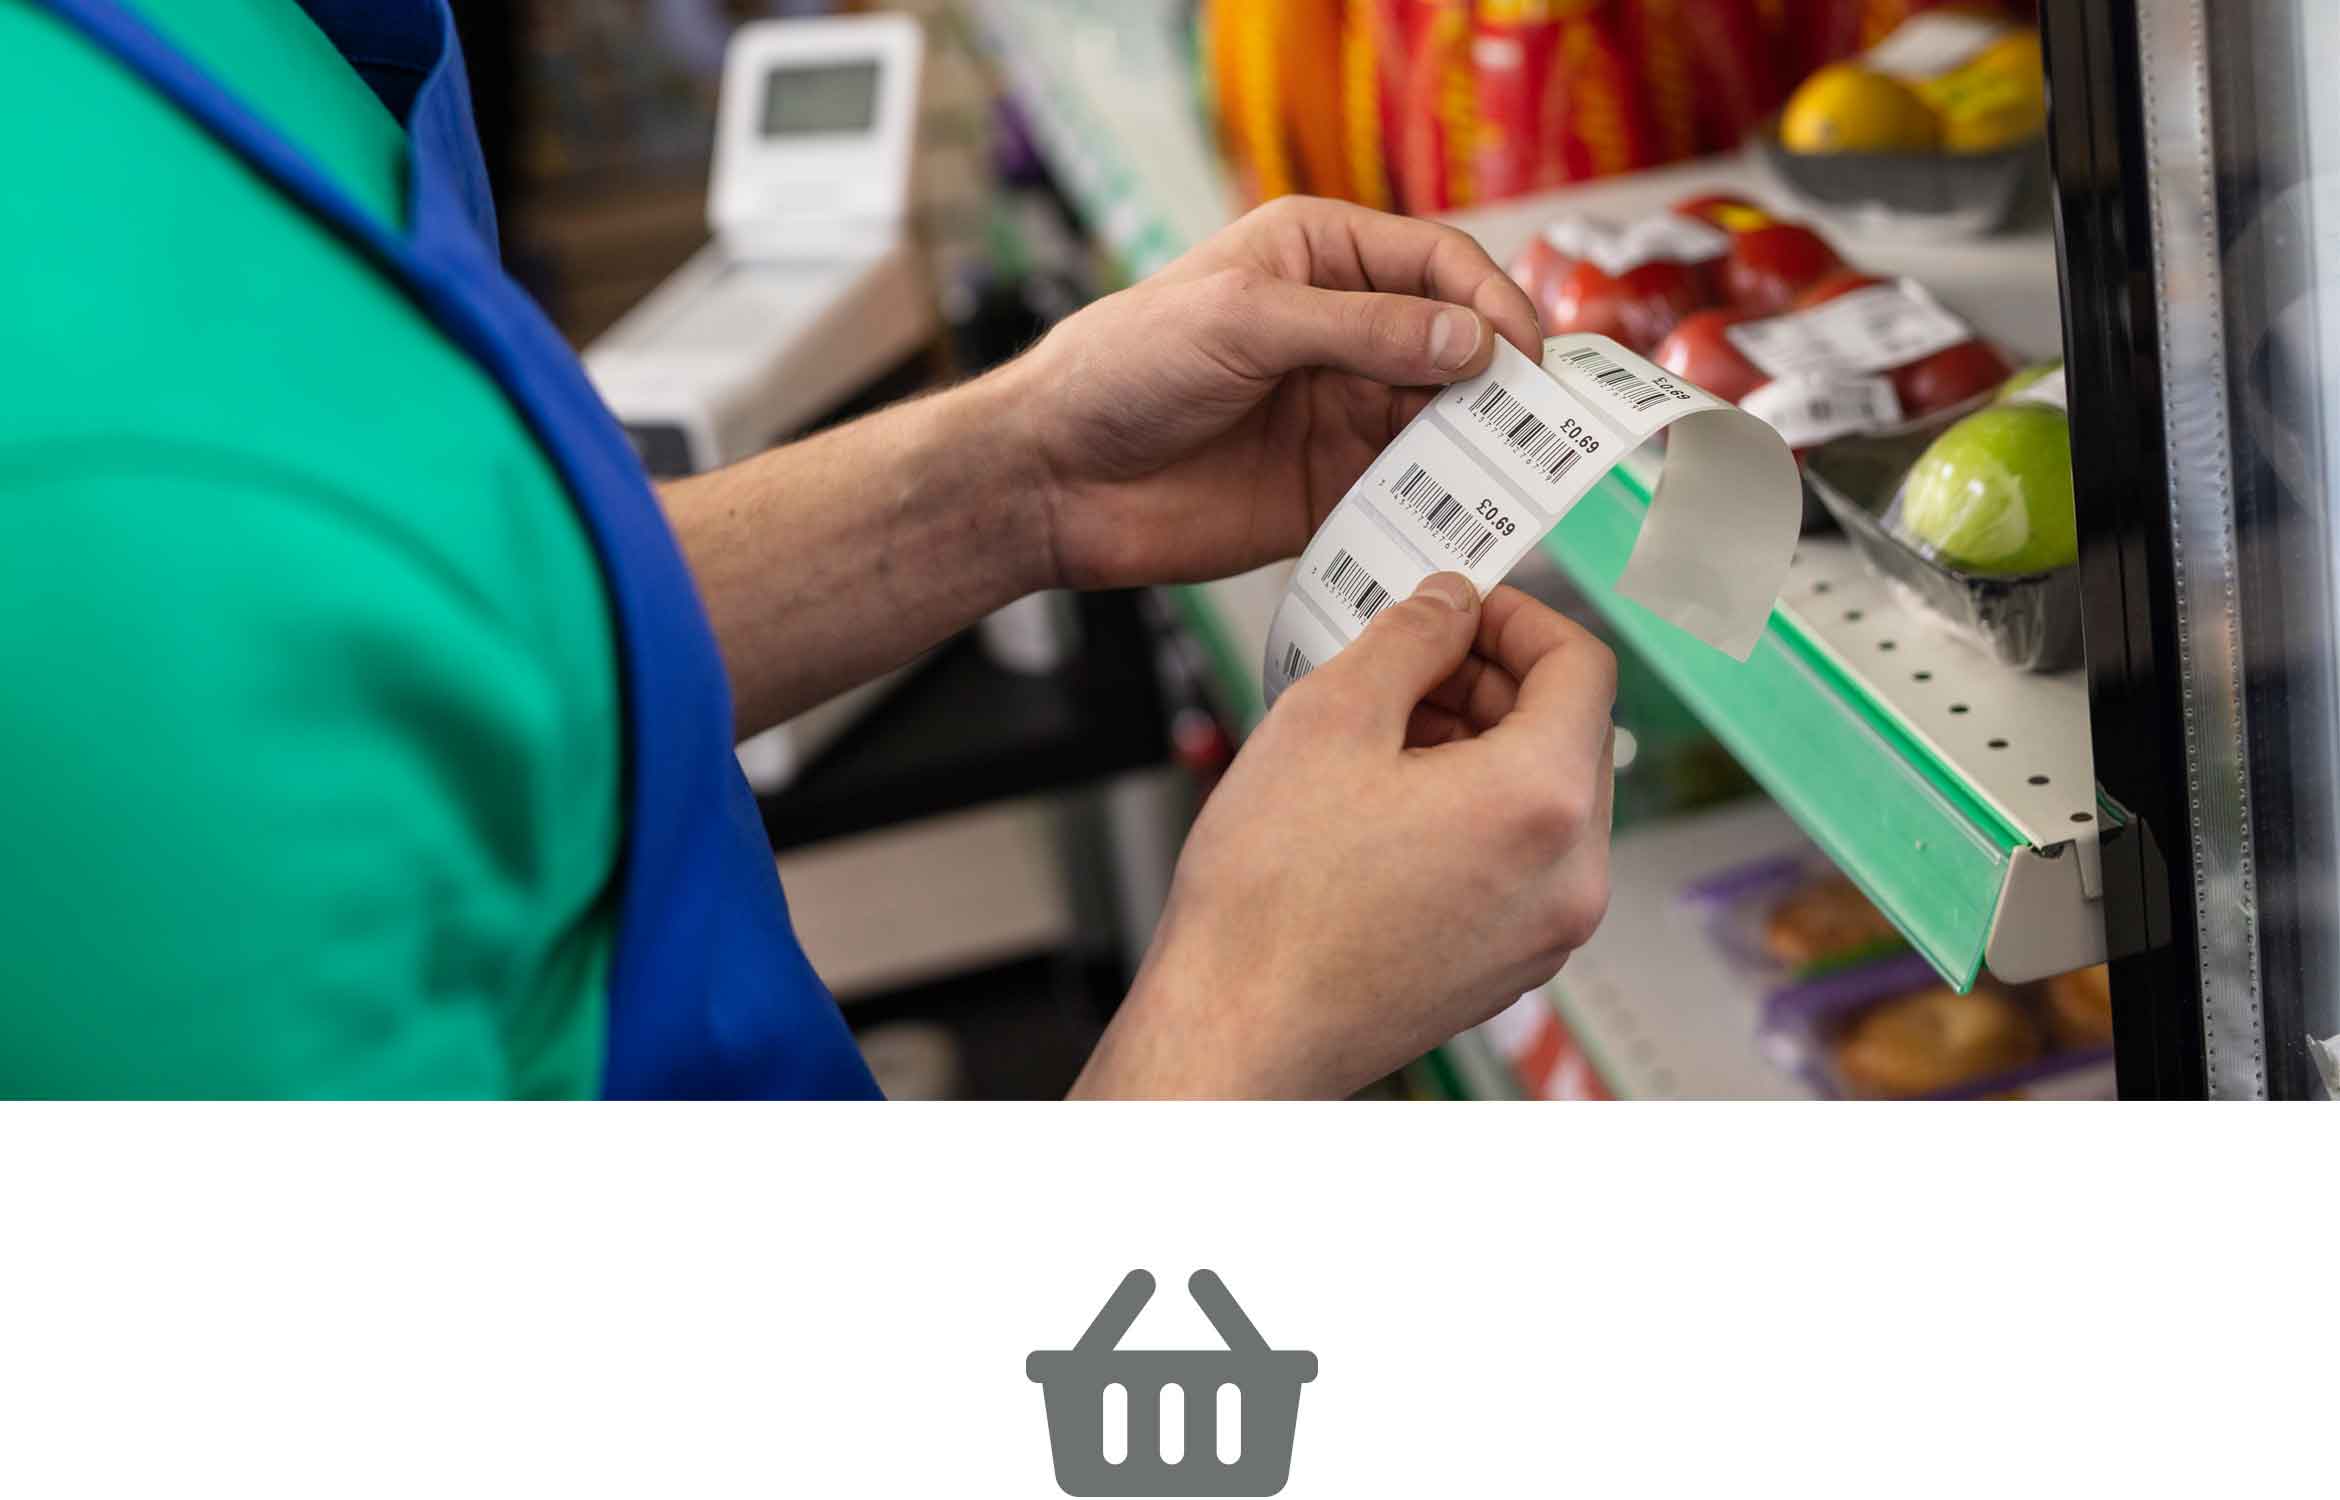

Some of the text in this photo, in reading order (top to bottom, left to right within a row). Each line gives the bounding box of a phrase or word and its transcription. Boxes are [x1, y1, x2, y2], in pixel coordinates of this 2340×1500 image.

[1652, 376, 1691, 401] £0.69
[1560, 418, 1600, 453] £0.69
[1476, 498, 1516, 536] £0.69
